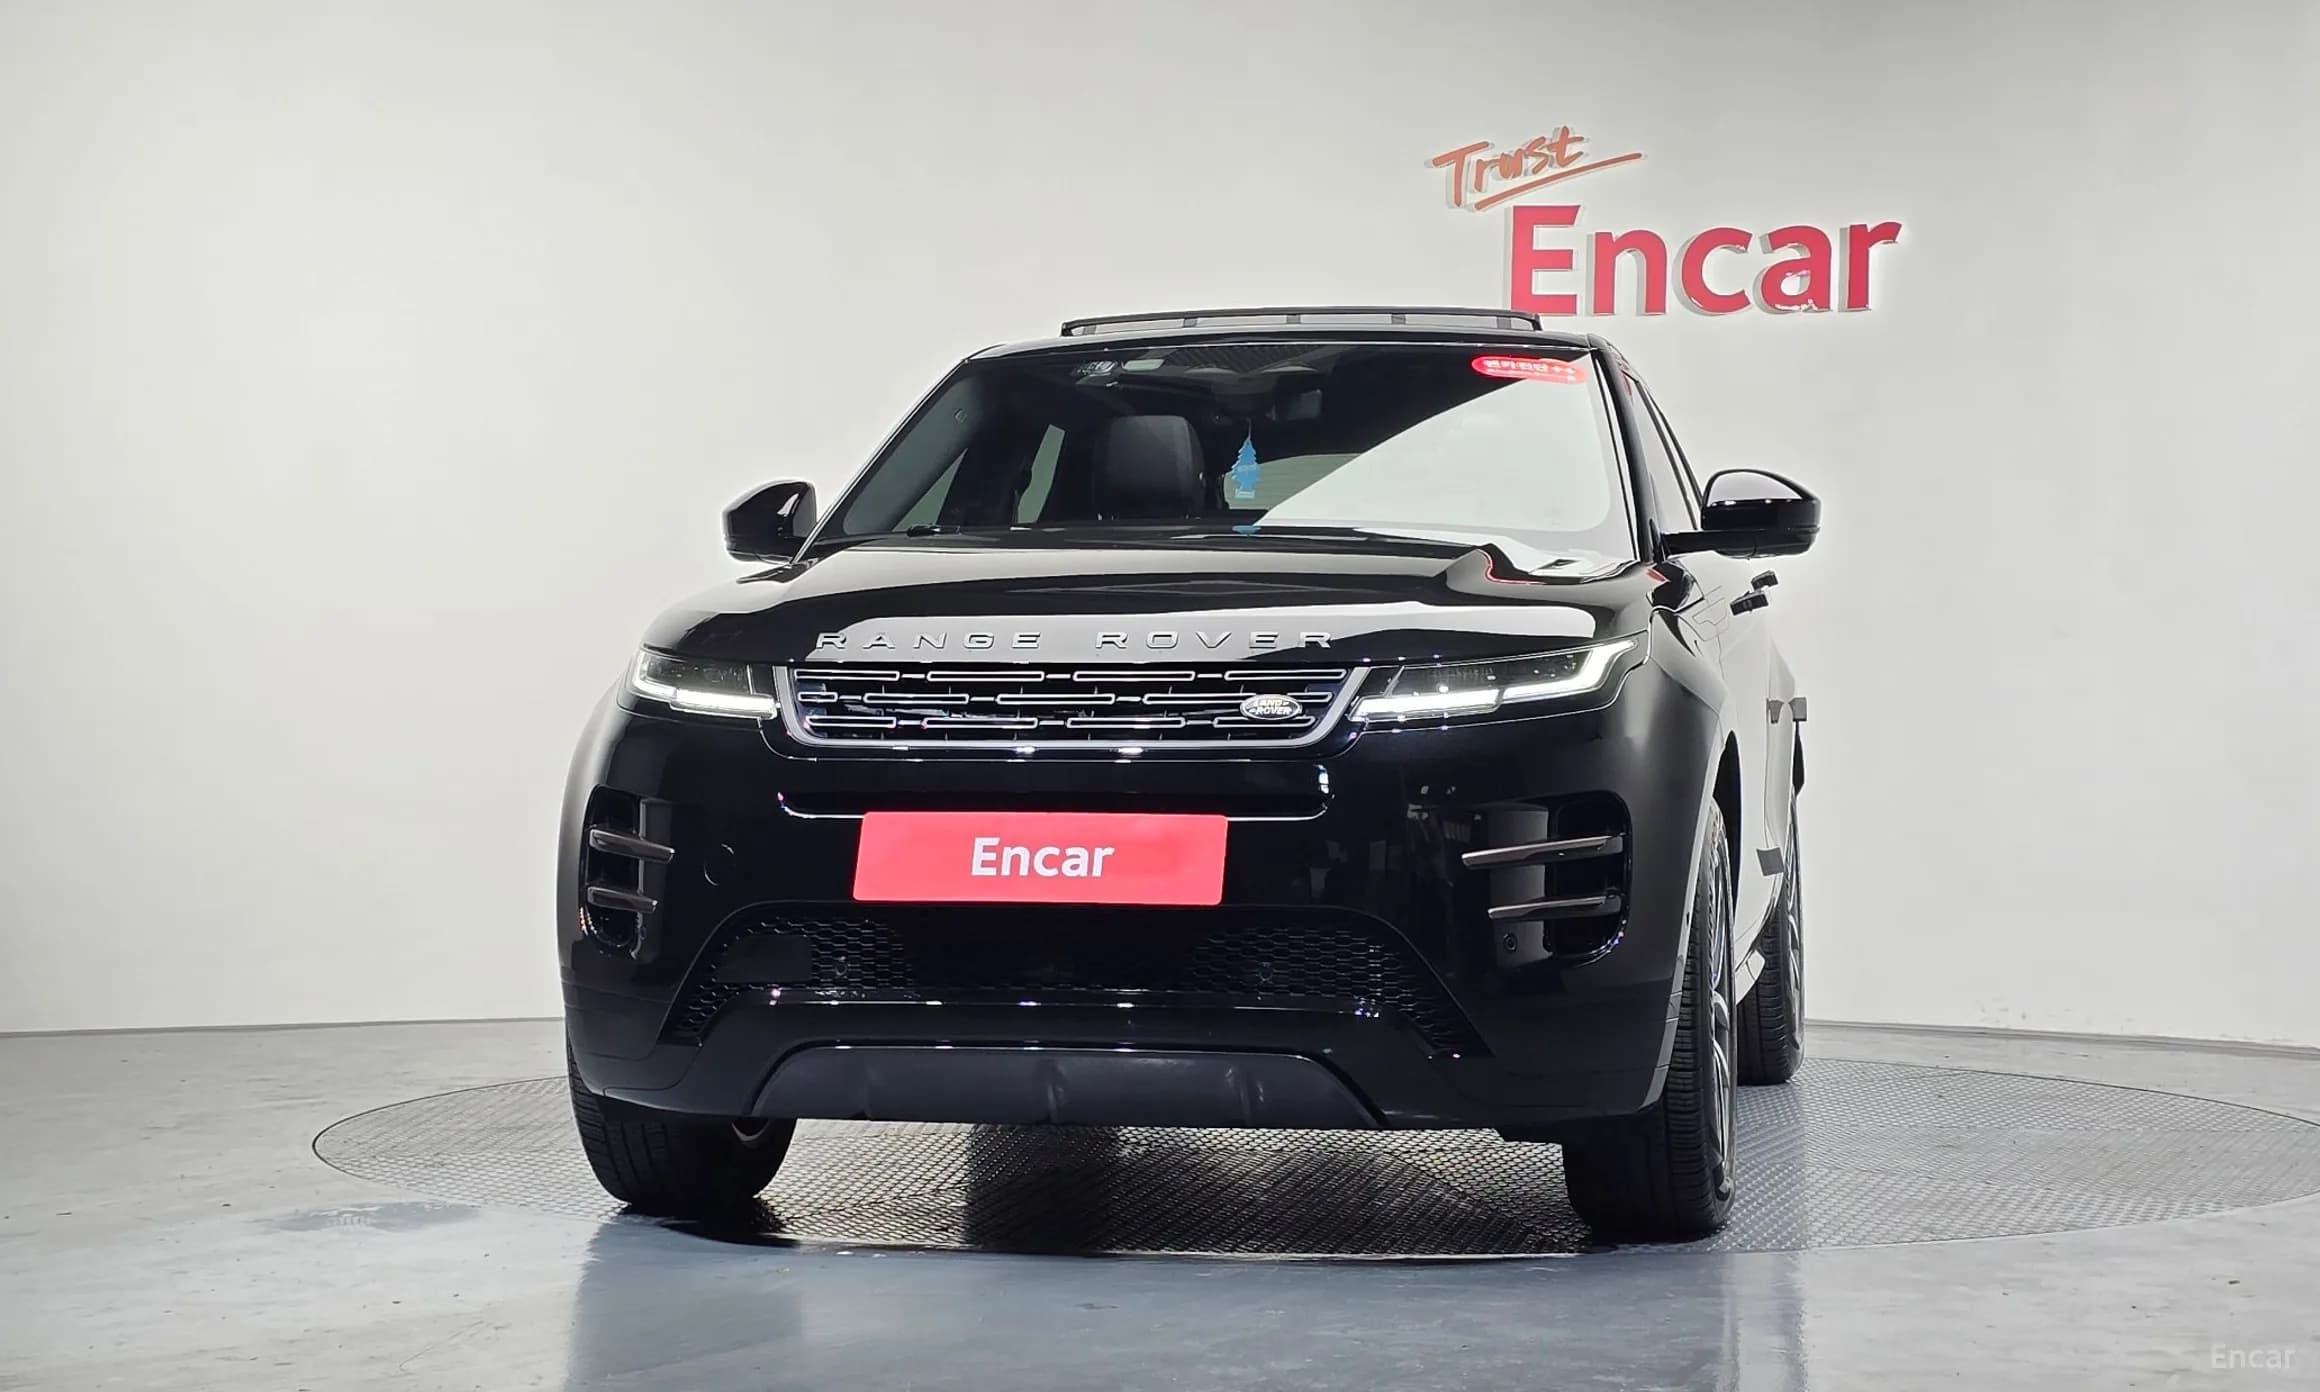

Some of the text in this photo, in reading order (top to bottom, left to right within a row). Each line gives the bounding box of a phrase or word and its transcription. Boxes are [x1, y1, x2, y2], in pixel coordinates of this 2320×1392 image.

[1432, 125, 1586, 208] Trust
[1508, 203, 1903, 315] Encar
[815, 630, 1332, 650] RANGE ROVER
[970, 836, 1115, 879] Encar
